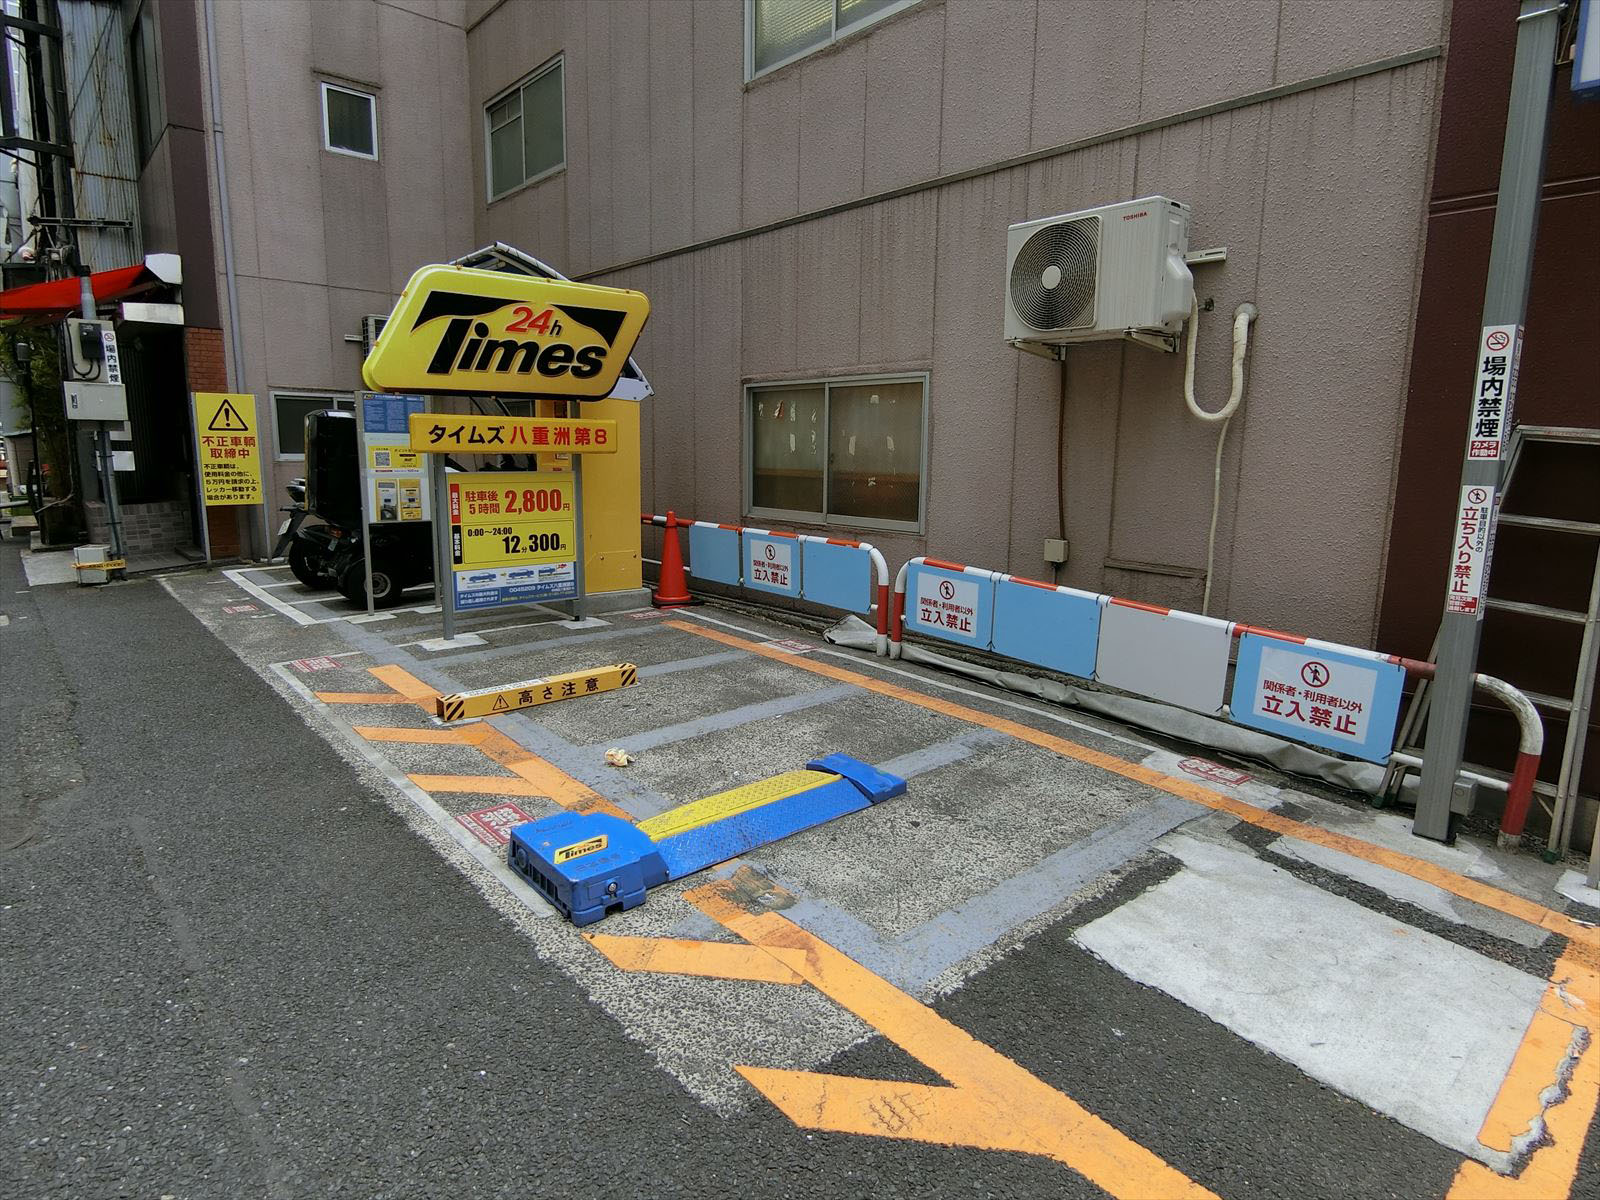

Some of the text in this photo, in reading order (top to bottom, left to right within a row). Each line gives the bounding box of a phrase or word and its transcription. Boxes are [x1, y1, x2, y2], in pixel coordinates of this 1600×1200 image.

[1123, 211, 1148, 221] TOSHIBA
[505, 306, 561, 336] 24h
[420, 314, 608, 379] Times
[1475, 356, 1507, 438] 場内禁煙
[211, 448, 250, 459] 取締中
[1473, 441, 1498, 449] カメラ
[465, 490, 499, 502] 駐車後
[469, 502, 500, 515] 5時間
[1452, 507, 1479, 593] 立ち入り禁止
[754, 569, 788, 586] 立入禁止
[920, 597, 973, 616] 関係者・利用者以外
[921, 608, 971, 632] 立入禁止
[518, 677, 599, 705] 高さ注意
[1263, 680, 1362, 714] 関係者・利用者以外
[1262, 695, 1356, 735] 立入禁止
[561, 840, 603, 860] Times
